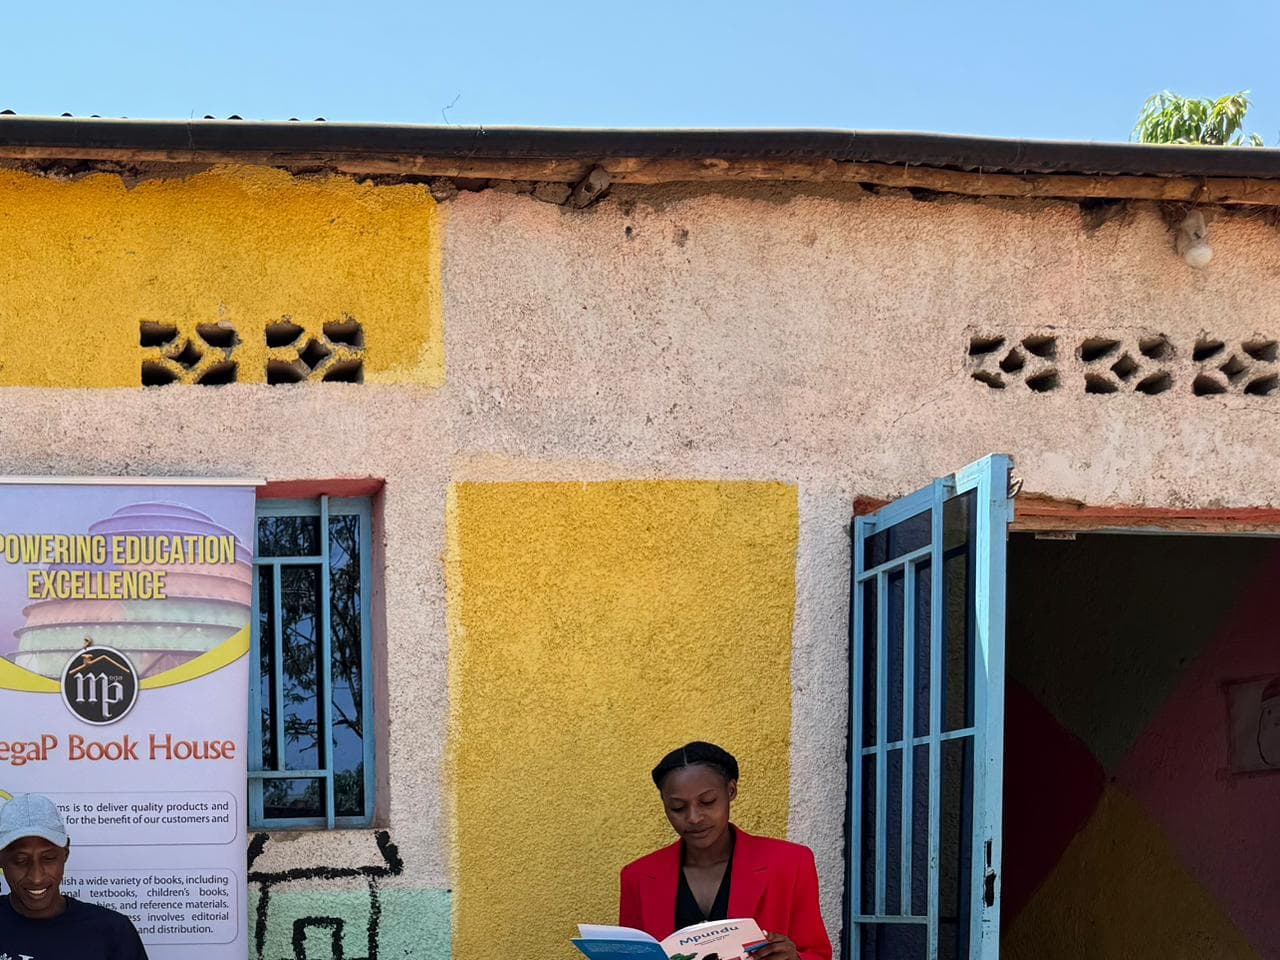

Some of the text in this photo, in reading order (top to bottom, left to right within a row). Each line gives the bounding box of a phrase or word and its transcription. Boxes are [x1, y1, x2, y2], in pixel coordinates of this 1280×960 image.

[112, 535, 235, 564] EDUCATION
[27, 570, 167, 600] EXCELLENCE
[68, 734, 139, 761] Book
[149, 734, 236, 760] House
[73, 802, 80, 812] is
[83, 803, 94, 812] to
[96, 802, 128, 812] deliver
[131, 802, 163, 815] quality
[166, 801, 208, 815] products
[211, 801, 229, 811] and
[66, 814, 229, 825] for the benefit of our customers and
[86, 876, 109, 886] wide
[110, 876, 140, 887] variety
[142, 875, 153, 885] of
[154, 875, 184, 886] books,
[185, 875, 229, 887] including
[90, 888, 138, 899] textbooks,
[199, 886, 229, 897] books,
[120, 901, 138, 910] and
[140, 900, 183, 910] reference
[185, 900, 229, 910] materials.
[148, 912, 185, 922] involves
[192, 912, 229, 921] editorial
[138, 925, 214, 935] and distribution.
[679, 926, 739, 946] Mpundu
